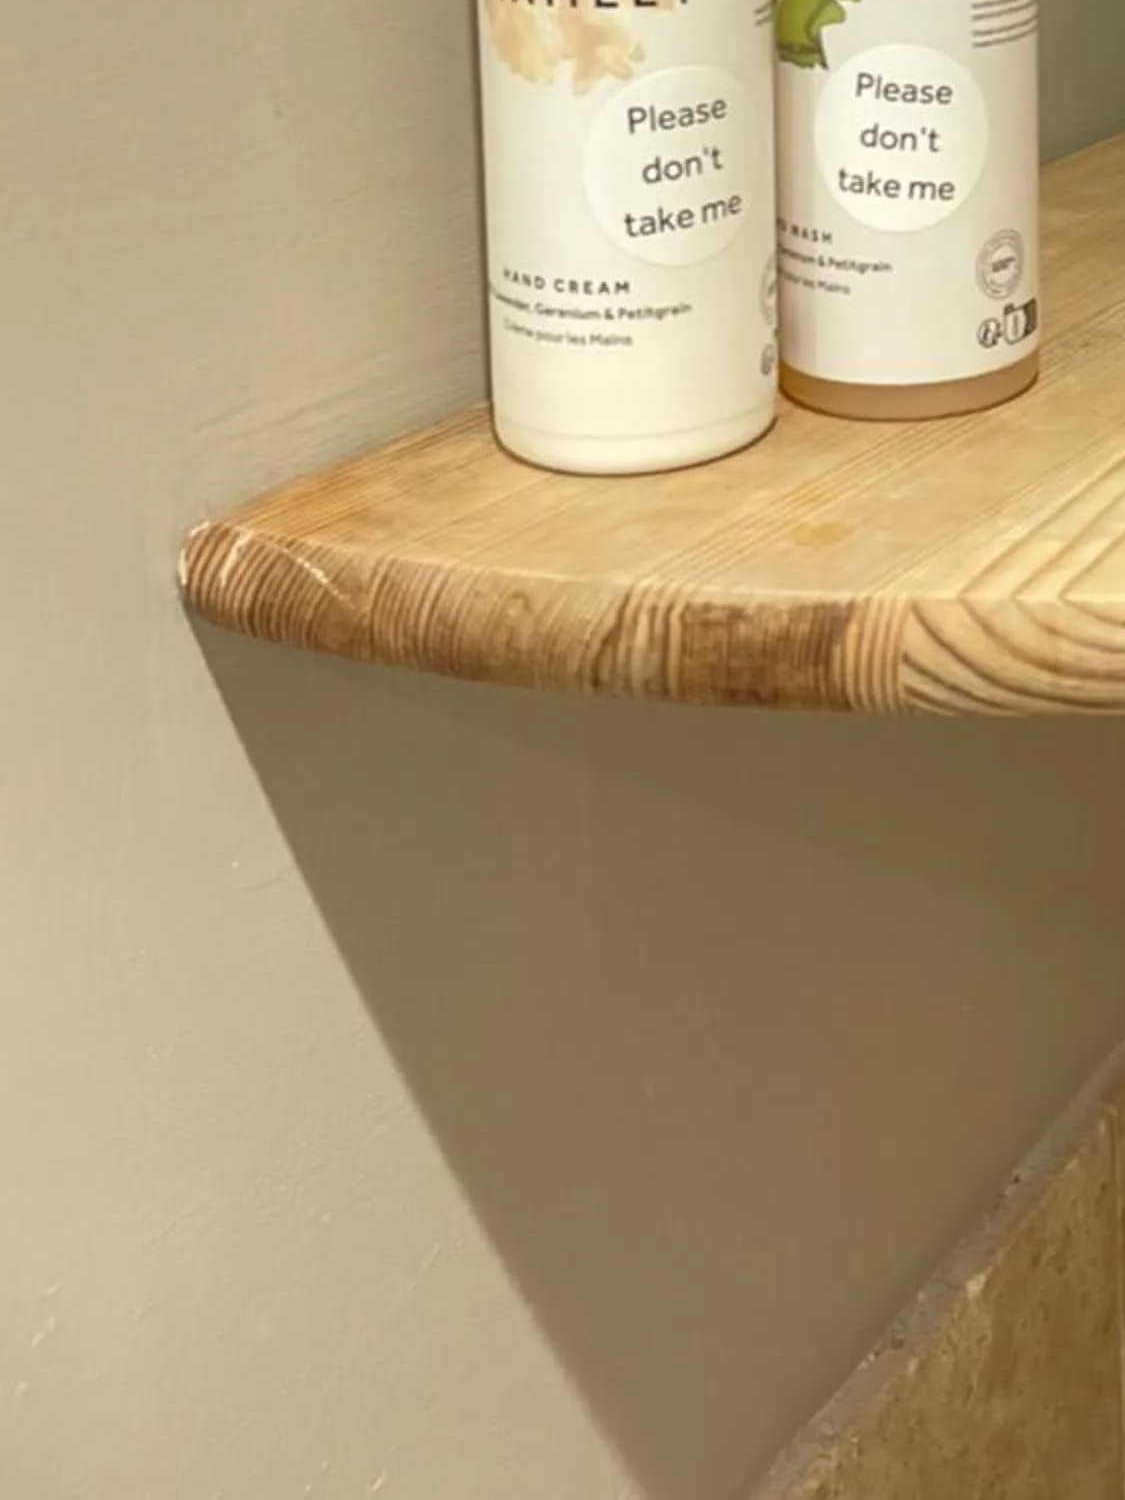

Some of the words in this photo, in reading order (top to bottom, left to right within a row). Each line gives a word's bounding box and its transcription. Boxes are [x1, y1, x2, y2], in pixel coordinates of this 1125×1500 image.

[856, 72, 953, 105] Please
[627, 99, 727, 134] Please
[860, 123, 940, 152] don't
[642, 146, 724, 184] don't
[838, 168, 901, 198] take
[907, 178, 955, 201] me
[624, 206, 696, 238] take
[701, 195, 742, 223] me
[553, 278, 631, 295] CREAM
